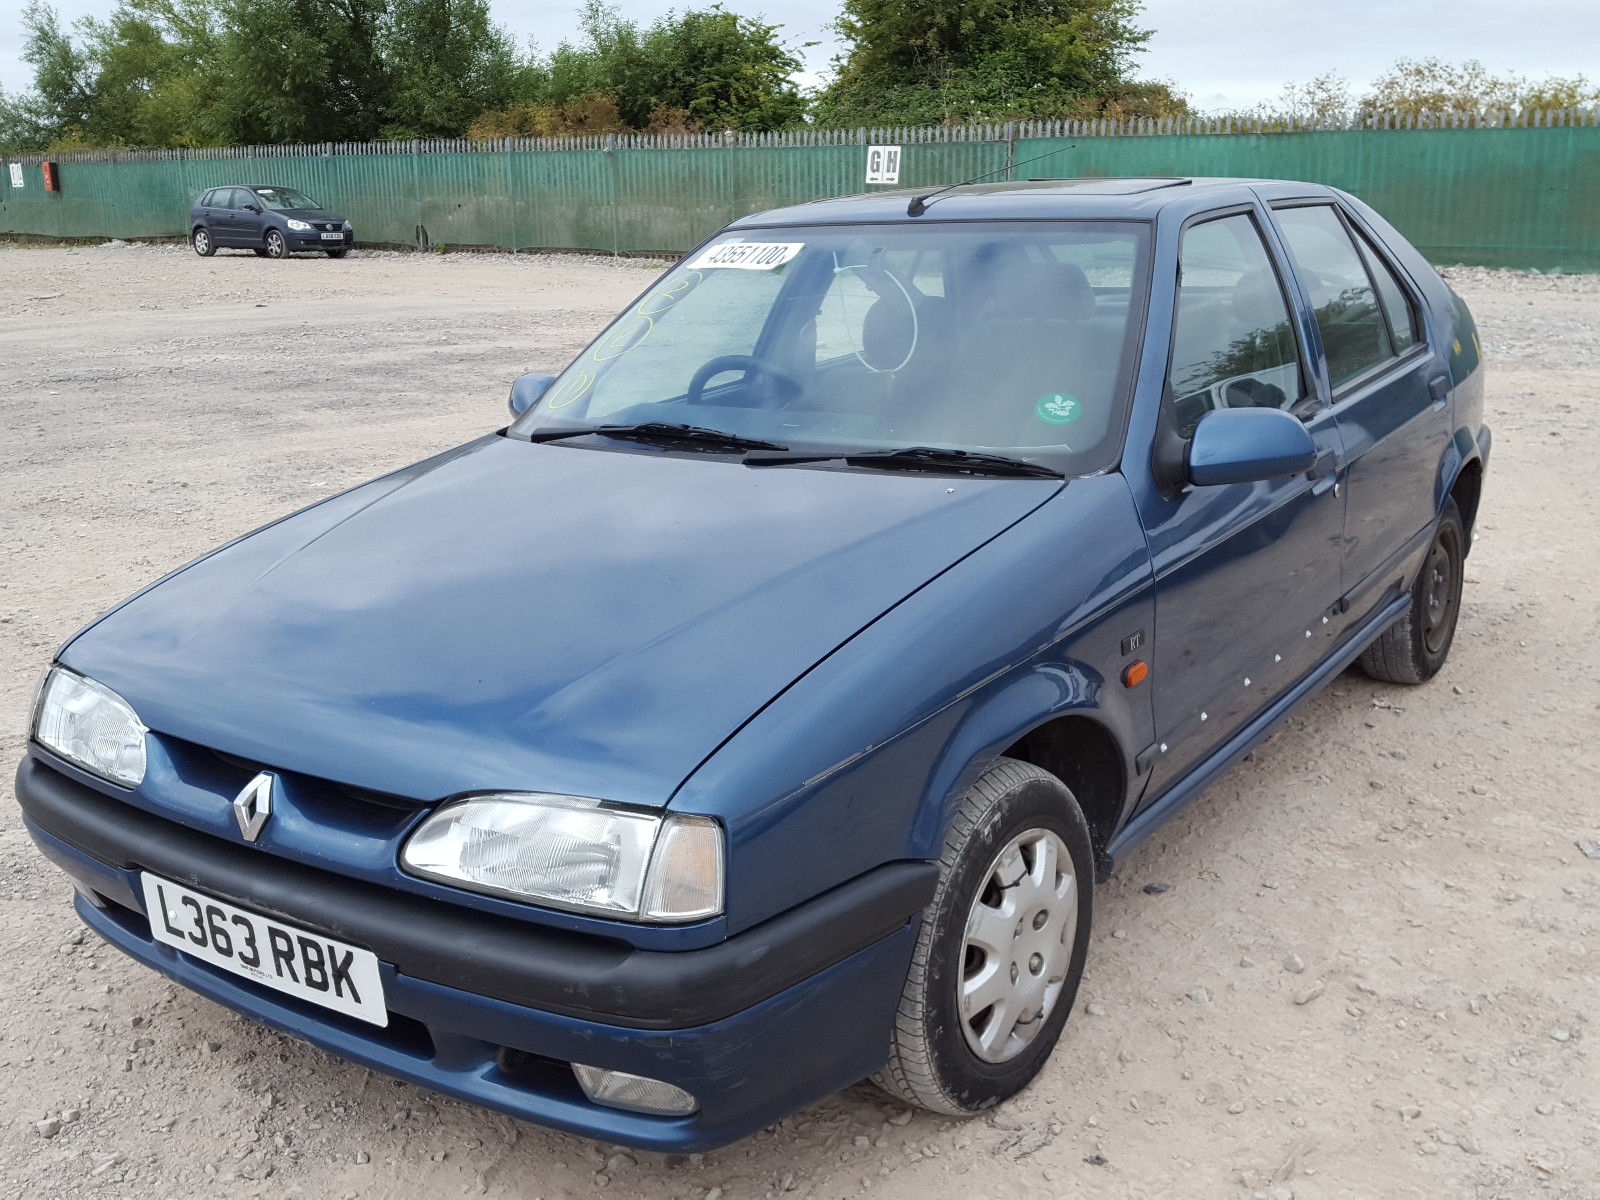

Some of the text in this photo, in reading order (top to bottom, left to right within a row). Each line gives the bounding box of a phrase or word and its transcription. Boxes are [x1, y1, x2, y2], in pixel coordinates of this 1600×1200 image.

[870, 150, 881, 173] G
[886, 151, 898, 173] H
[1130, 633, 1141, 651] RT
[156, 884, 363, 1005] L363 RBK
